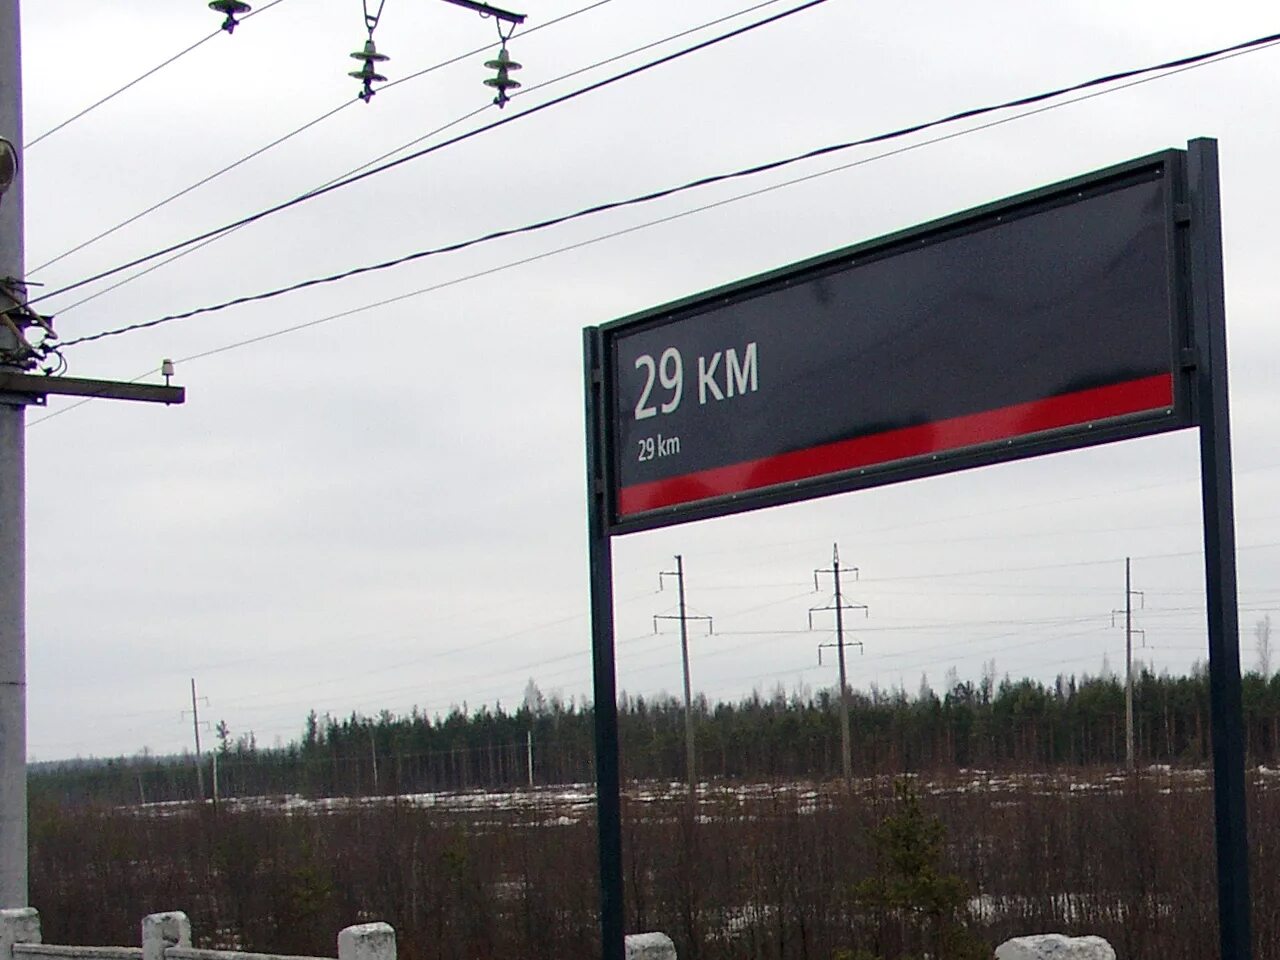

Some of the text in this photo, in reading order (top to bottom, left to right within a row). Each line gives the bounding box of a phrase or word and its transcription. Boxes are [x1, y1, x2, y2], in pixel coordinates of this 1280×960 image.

[634, 347, 684, 420] 29
[638, 433, 680, 462] 29 km
